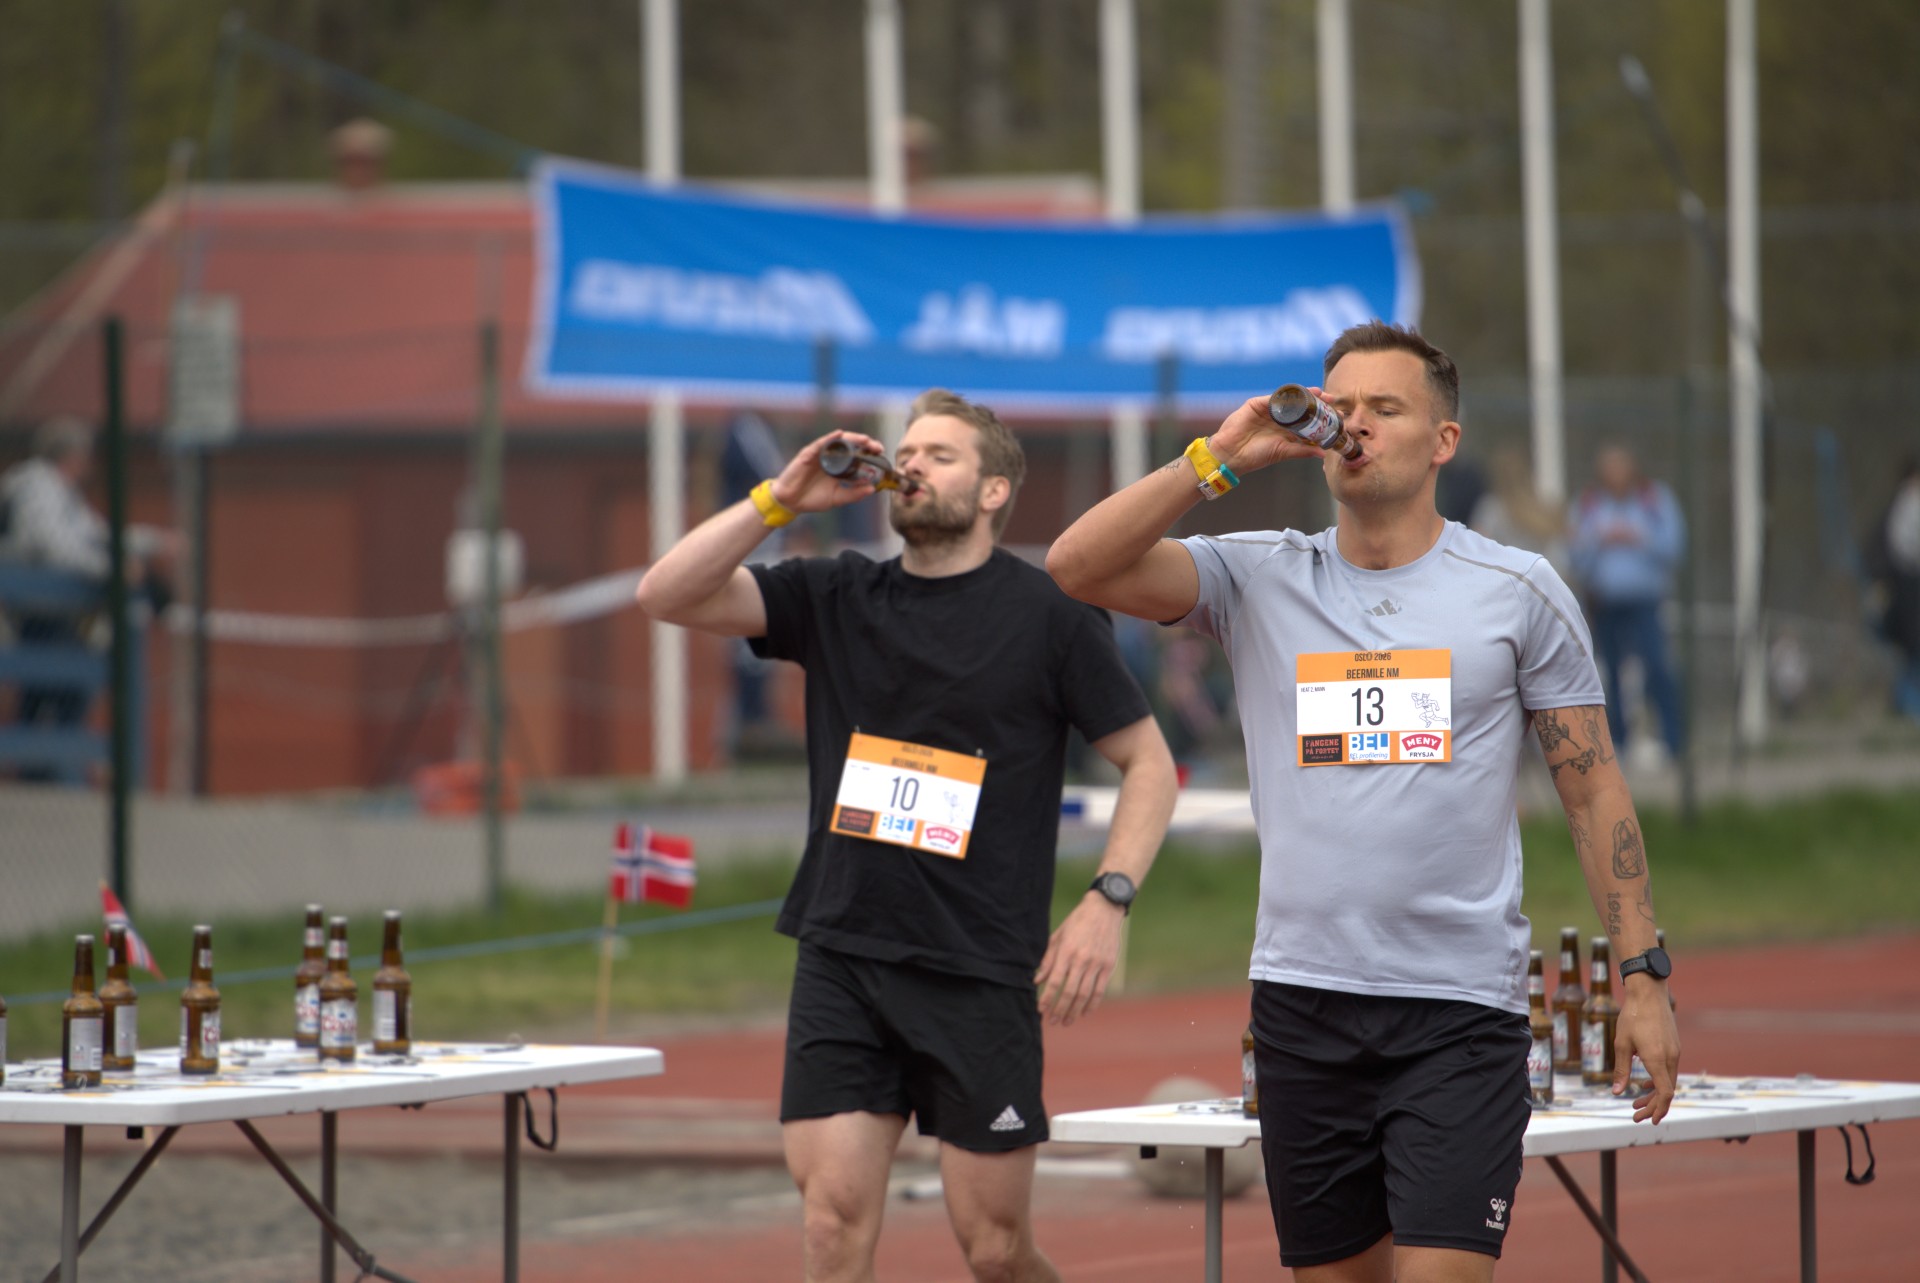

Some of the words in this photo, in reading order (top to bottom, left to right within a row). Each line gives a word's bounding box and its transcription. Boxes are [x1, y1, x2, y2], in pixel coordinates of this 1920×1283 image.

[1346, 668, 1384, 679] BEERMILE
[1386, 667, 1400, 678] NM
[1351, 687, 1384, 726] 13
[1305, 738, 1340, 747] FANGENE
[1351, 734, 1388, 750] BEL
[1406, 737, 1439, 747] MENY
[1315, 747, 1340, 755] FORTET
[1359, 752, 1389, 760] profilering
[890, 776, 920, 812] 10
